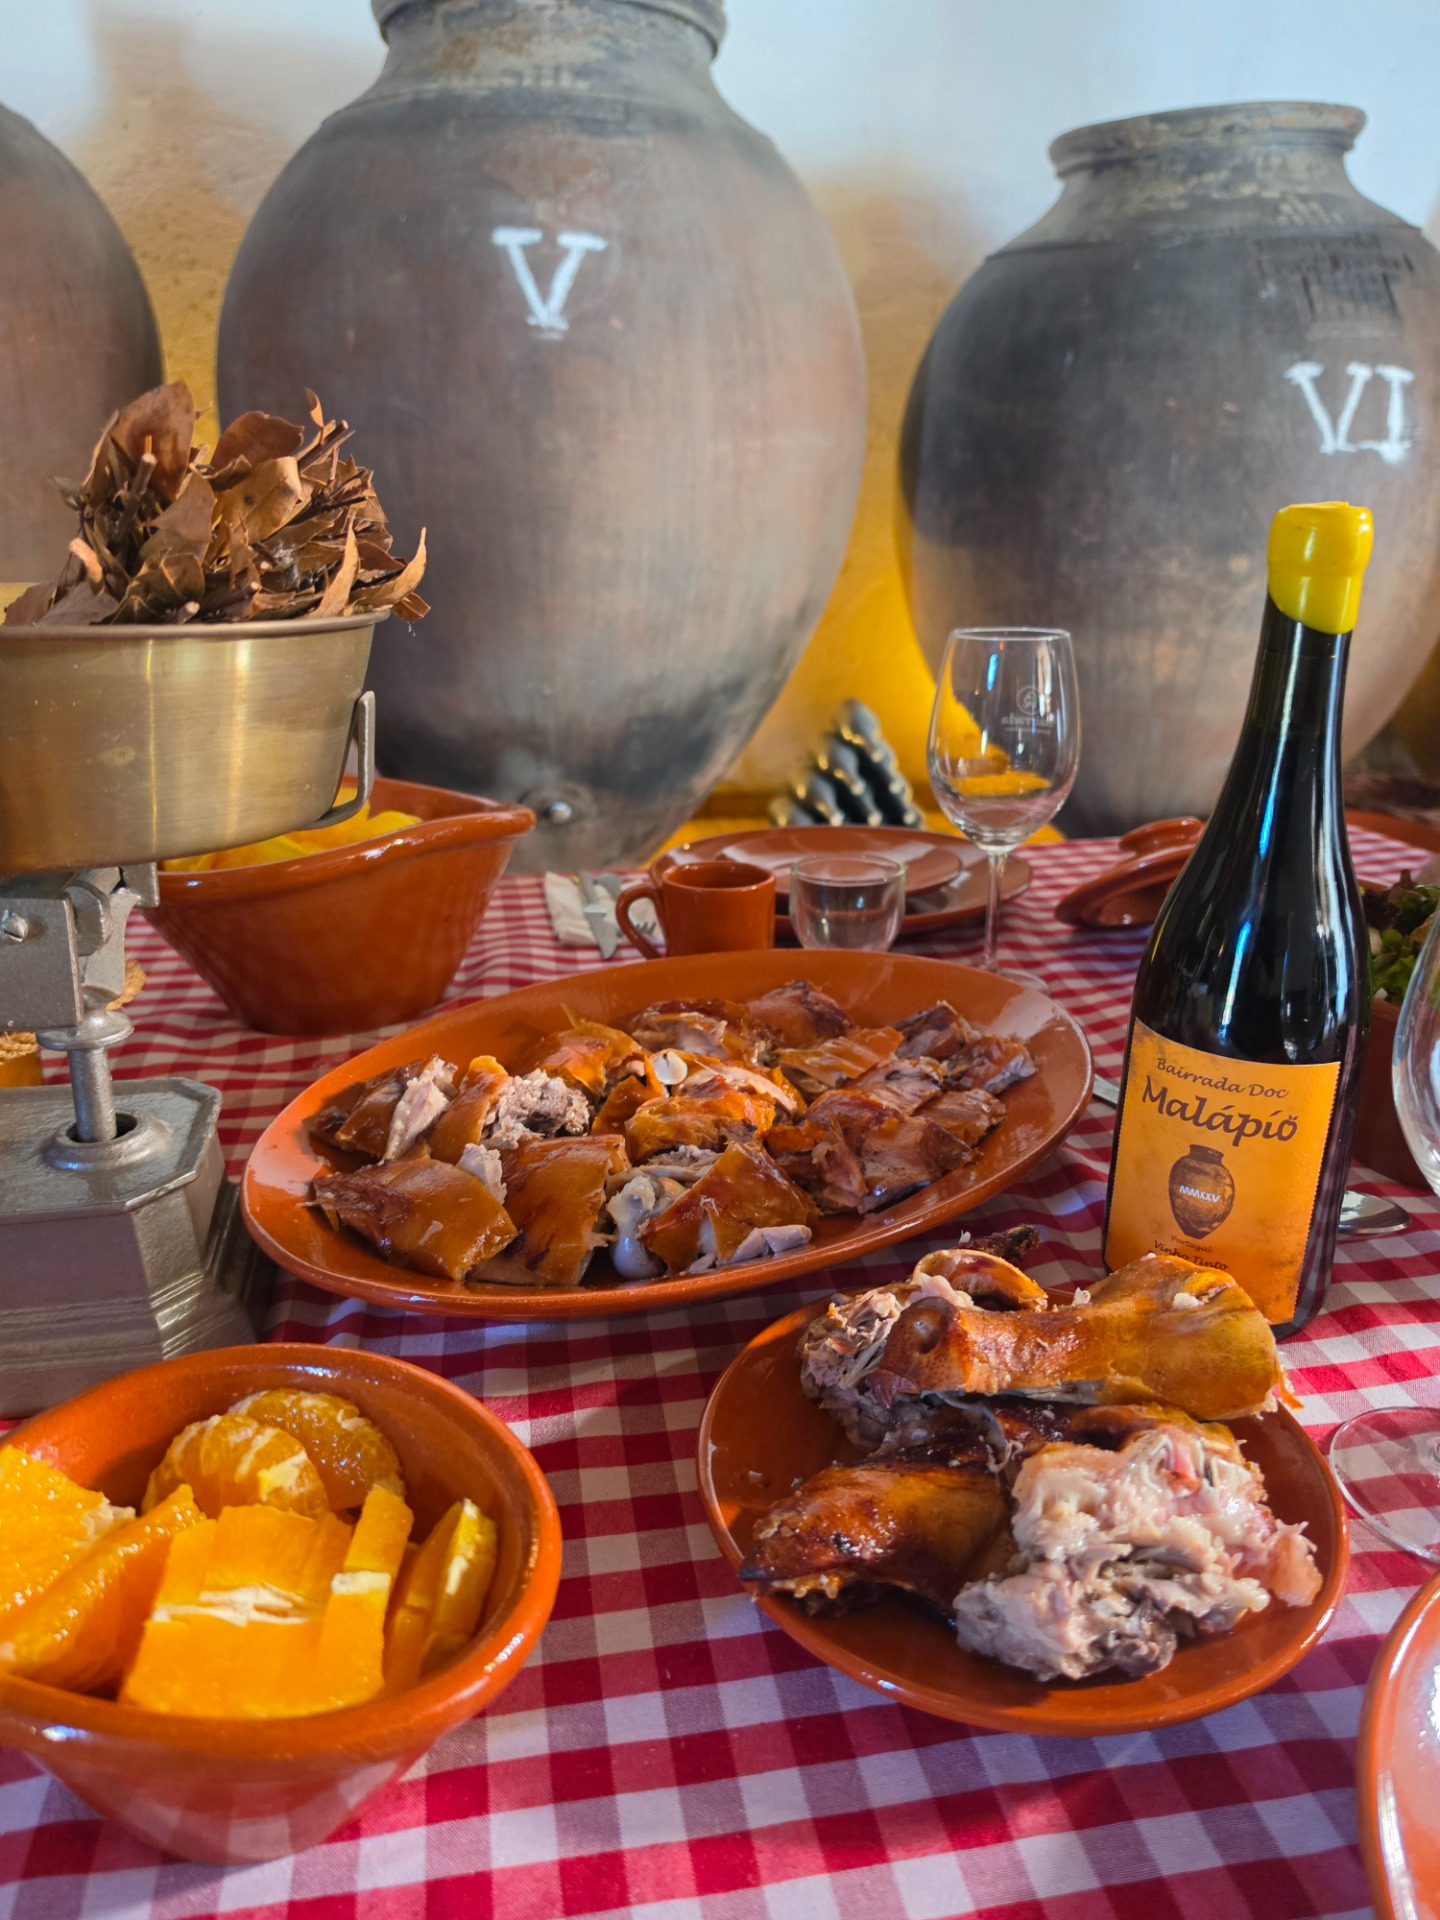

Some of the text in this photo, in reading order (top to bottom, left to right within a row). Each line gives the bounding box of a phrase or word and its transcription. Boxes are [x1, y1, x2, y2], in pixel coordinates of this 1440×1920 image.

[492, 226, 608, 335] V
[1283, 361, 1415, 465] VI
[1157, 1057, 1290, 1099] Bairrada Doc
[1179, 1184, 1222, 1203] MMXXV
[1154, 1239, 1230, 1271] Vinho Tinto
[1171, 1235, 1214, 1254] Portugal
